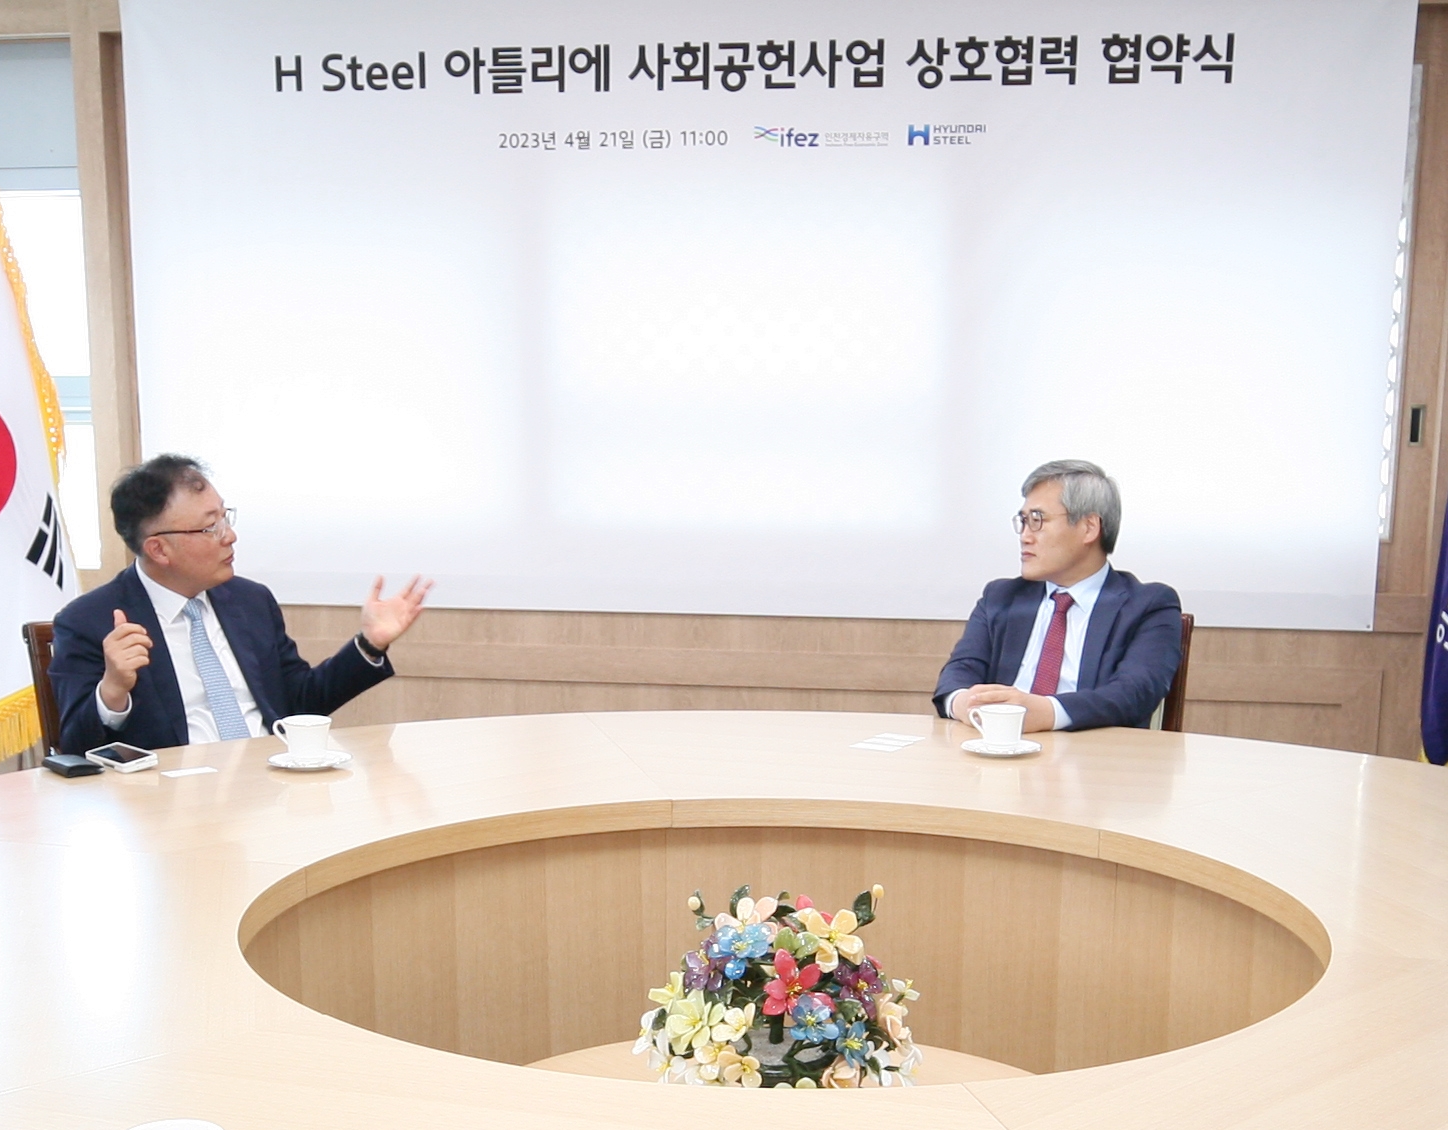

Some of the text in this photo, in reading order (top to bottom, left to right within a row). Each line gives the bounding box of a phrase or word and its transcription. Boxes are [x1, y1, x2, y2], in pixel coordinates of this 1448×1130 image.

[274, 32, 1236, 95] H Steel 아틀리에 사회공헌사업 상호협력 협약식
[780, 127, 820, 148] ifez
[933, 124, 987, 134] HYUNDAI
[498, 129, 729, 151] 2023년 4월 21일 (금) 11:00
[933, 135, 972, 145] STEEL
